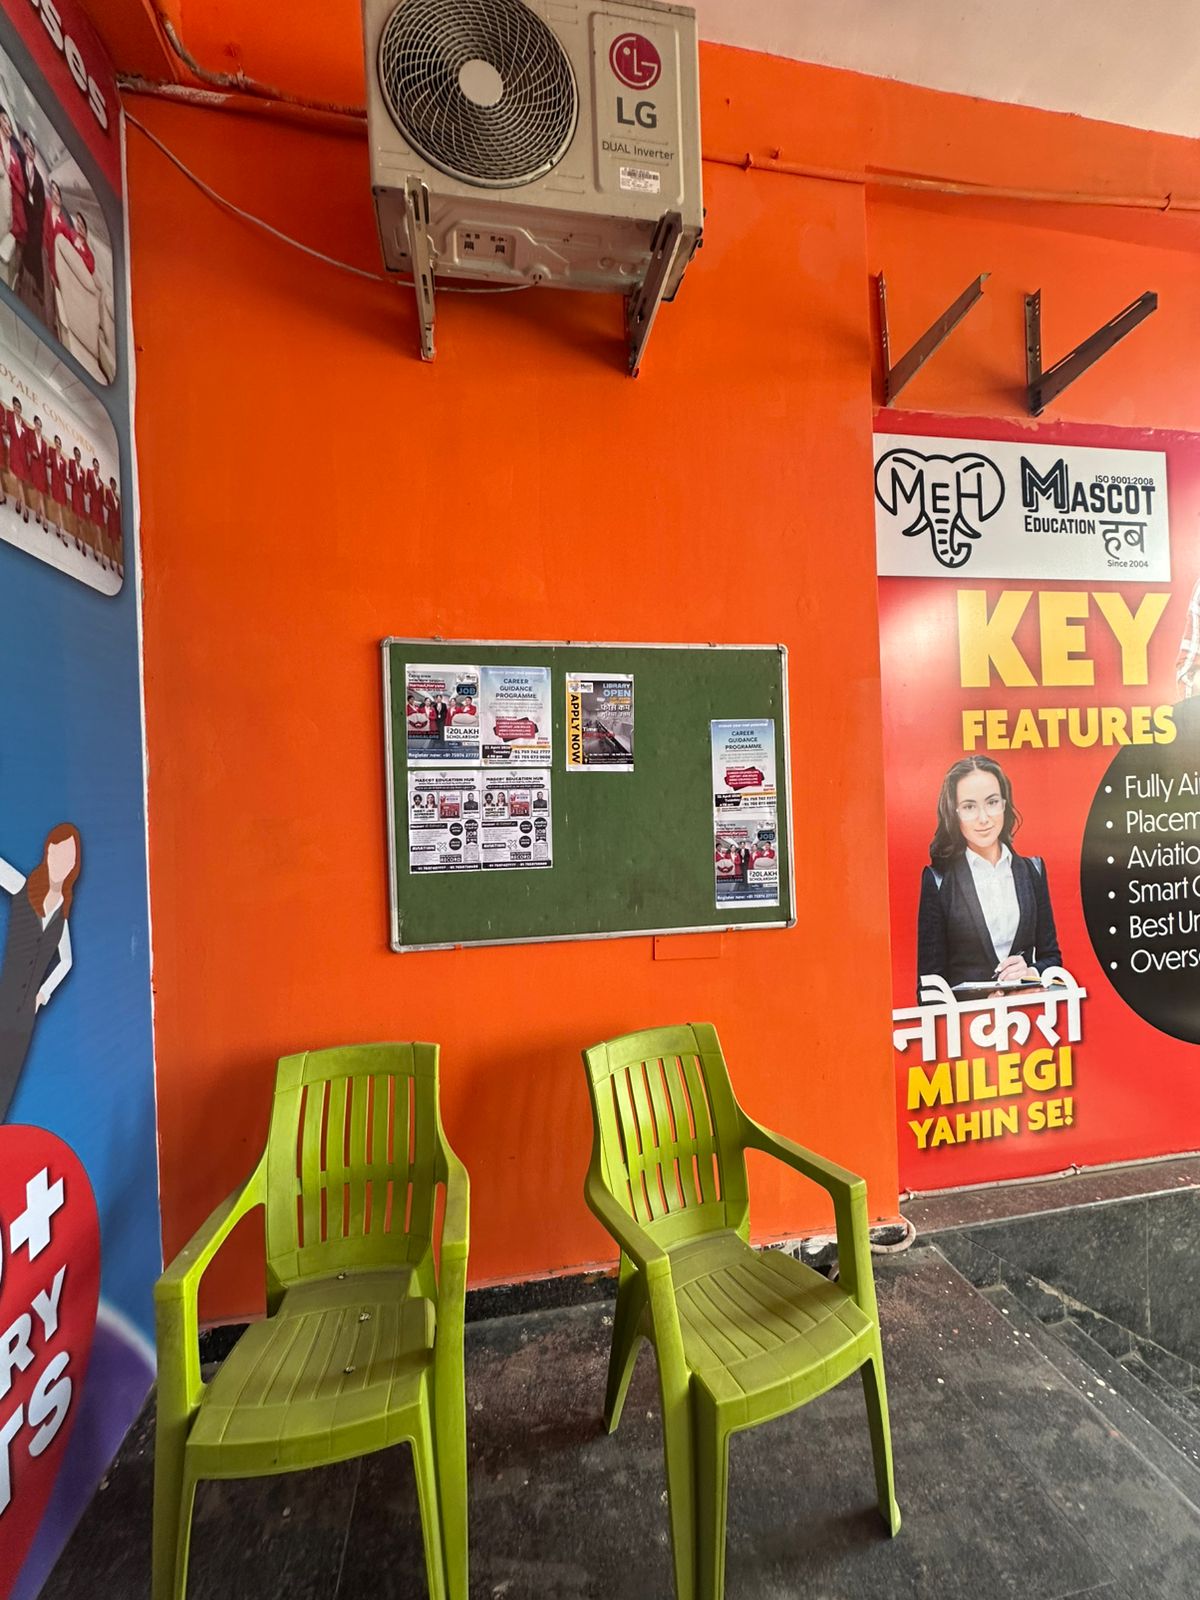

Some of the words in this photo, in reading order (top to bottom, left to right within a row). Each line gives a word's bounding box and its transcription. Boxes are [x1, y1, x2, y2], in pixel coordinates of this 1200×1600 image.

[30, 0, 108, 130] ses
[616, 96, 658, 129] LG
[602, 140, 631, 154] DUAL
[633, 144, 675, 161] Inverter
[1095, 474, 1109, 484] ISO
[1110, 475, 1154, 486] 9001:2008
[1098, 520, 1148, 560] हब
[1107, 560, 1128, 568] Since
[1128, 560, 1149, 568] 2004
[957, 590, 1172, 688] KEY
[458, 687, 476, 695] JOB
[603, 689, 631, 697] OPEN
[570, 694, 580, 731] APPLY
[962, 705, 1177, 751] FEATURES
[571, 733, 581, 764] NOW
[1125, 773, 1174, 803] Fully
[1178, 771, 1200, 796] Ai
[1128, 876, 1189, 903] Smart
[1130, 912, 1174, 938] Best
[892, 966, 1087, 1062] नौकरी
[907, 1045, 1073, 1110] MILEGI
[908, 1104, 1019, 1149] YAHIN
[1027, 1096, 1074, 1132] SE!
